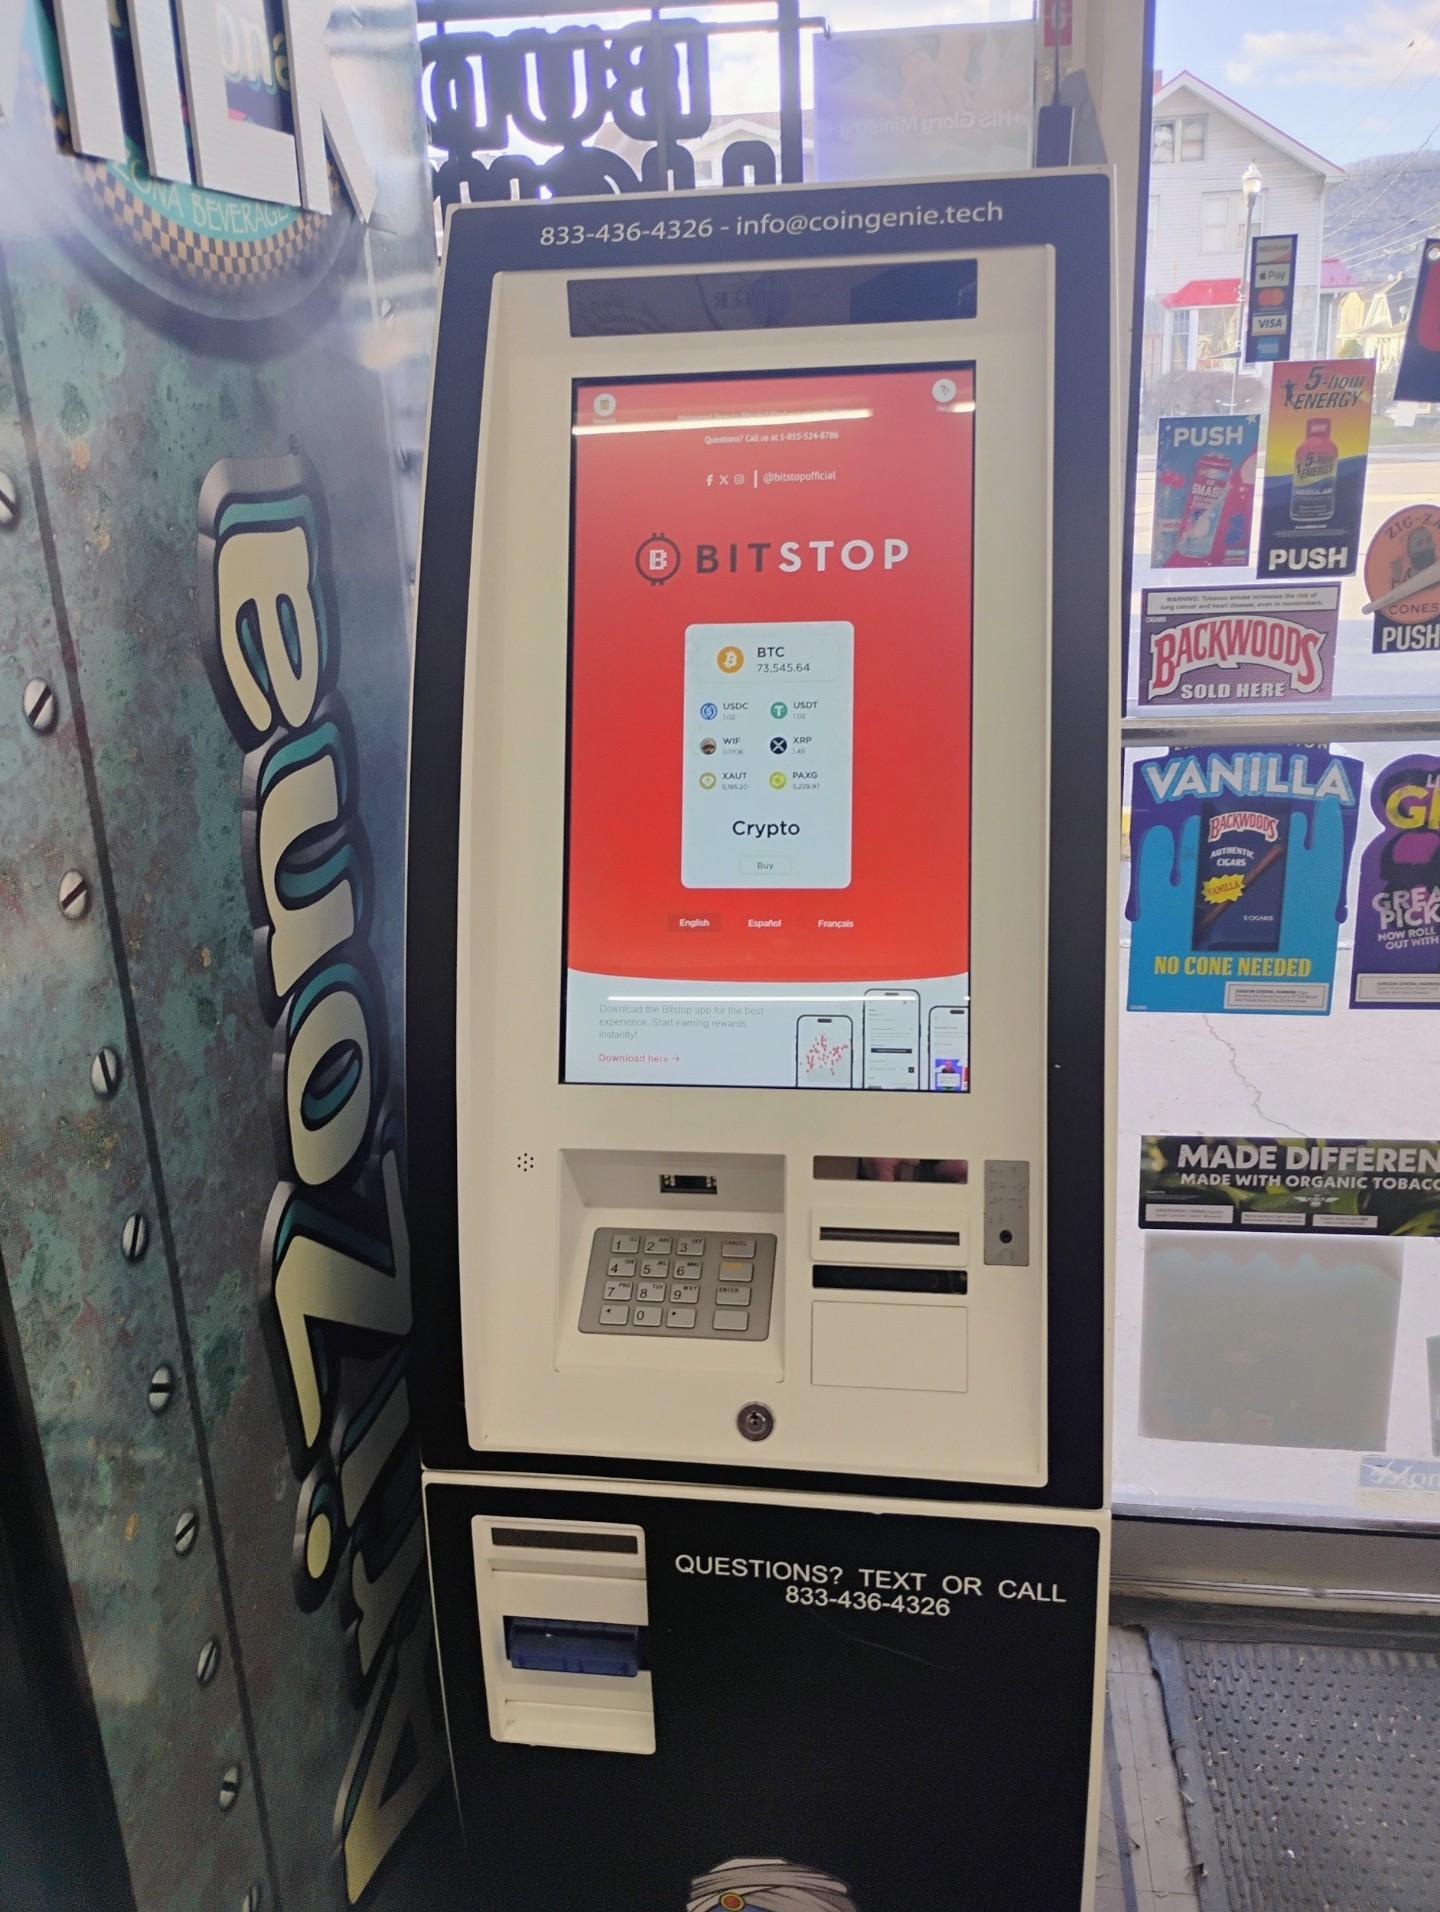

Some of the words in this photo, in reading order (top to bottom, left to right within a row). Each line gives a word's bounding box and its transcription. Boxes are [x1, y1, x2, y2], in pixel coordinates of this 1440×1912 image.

[540, 216, 713, 247] 833-436-4326
[736, 200, 1003, 237] info@coingenie.tech
[1258, 318, 1282, 329] VISA
[1304, 365, 1367, 391] 5-hour
[1295, 390, 1363, 410] ENERGY
[704, 434, 744, 446] Questions?
[745, 434, 759, 443] Call
[1173, 425, 1243, 447] PUSH
[763, 470, 837, 485] @bitstopofficial
[697, 538, 910, 574] BITSTOP
[1268, 547, 1349, 571] PUSH
[1388, 602, 1440, 616] CONES
[1381, 624, 1440, 652] PUSH
[756, 646, 785, 658] BTC
[1150, 617, 1323, 692] BACKWOODS
[756, 661, 811, 674] 73,545.64
[1180, 683, 1230, 700] SOLD
[1237, 682, 1286, 699] HERE
[722, 702, 749, 711] USDC
[793, 701, 818, 710] USDT
[722, 737, 741, 745] WIF
[793, 736, 812, 745] XRP
[722, 771, 748, 780] XAUT
[792, 771, 818, 780] PAXG
[1145, 755, 1351, 803] VANILLA
[732, 820, 801, 839] Crypto
[1209, 813, 1278, 841] BACKWOODS
[1210, 847, 1255, 859] AUTHENTIC
[757, 861, 774, 871] Buy
[1216, 858, 1247, 867] CIGARS
[679, 918, 710, 928] English
[747, 918, 782, 929] Español
[817, 919, 854, 929] Français
[1378, 929, 1406, 942] NOW
[1408, 927, 1437, 939] ROLL
[1385, 939, 1408, 950] OUT
[1411, 936, 1440, 947] WITH
[1154, 956, 1179, 975] NO
[1184, 956, 1233, 976] CONE
[1237, 957, 1312, 978] NEEDED
[599, 1003, 643, 1015] Download
[645, 1004, 659, 1014] the
[744, 1006, 764, 1016] best
[598, 1053, 645, 1063] Download
[1177, 1144, 1278, 1169] MADE
[1181, 1173, 1231, 1186] MADE
[1236, 1174, 1281, 1187] WITH
[1285, 1174, 1368, 1190] ORGANIC
[646, 1241, 655, 1252] 2
[680, 1242, 688, 1253] 3
[610, 1263, 618, 1274] 4
[643, 1264, 651, 1275] 5
[676, 1266, 685, 1277] 6
[607, 1287, 615, 1298] 7
[639, 1288, 648, 1299] 8
[673, 1289, 682, 1300] 9
[636, 1310, 645, 1321] 0
[674, 1553, 844, 1586] QUESTIONS?
[858, 1568, 927, 1592] TEXT
[941, 1574, 983, 1597] OR
[998, 1579, 1068, 1604] CALL
[785, 1586, 951, 1618] 833-436-4326
